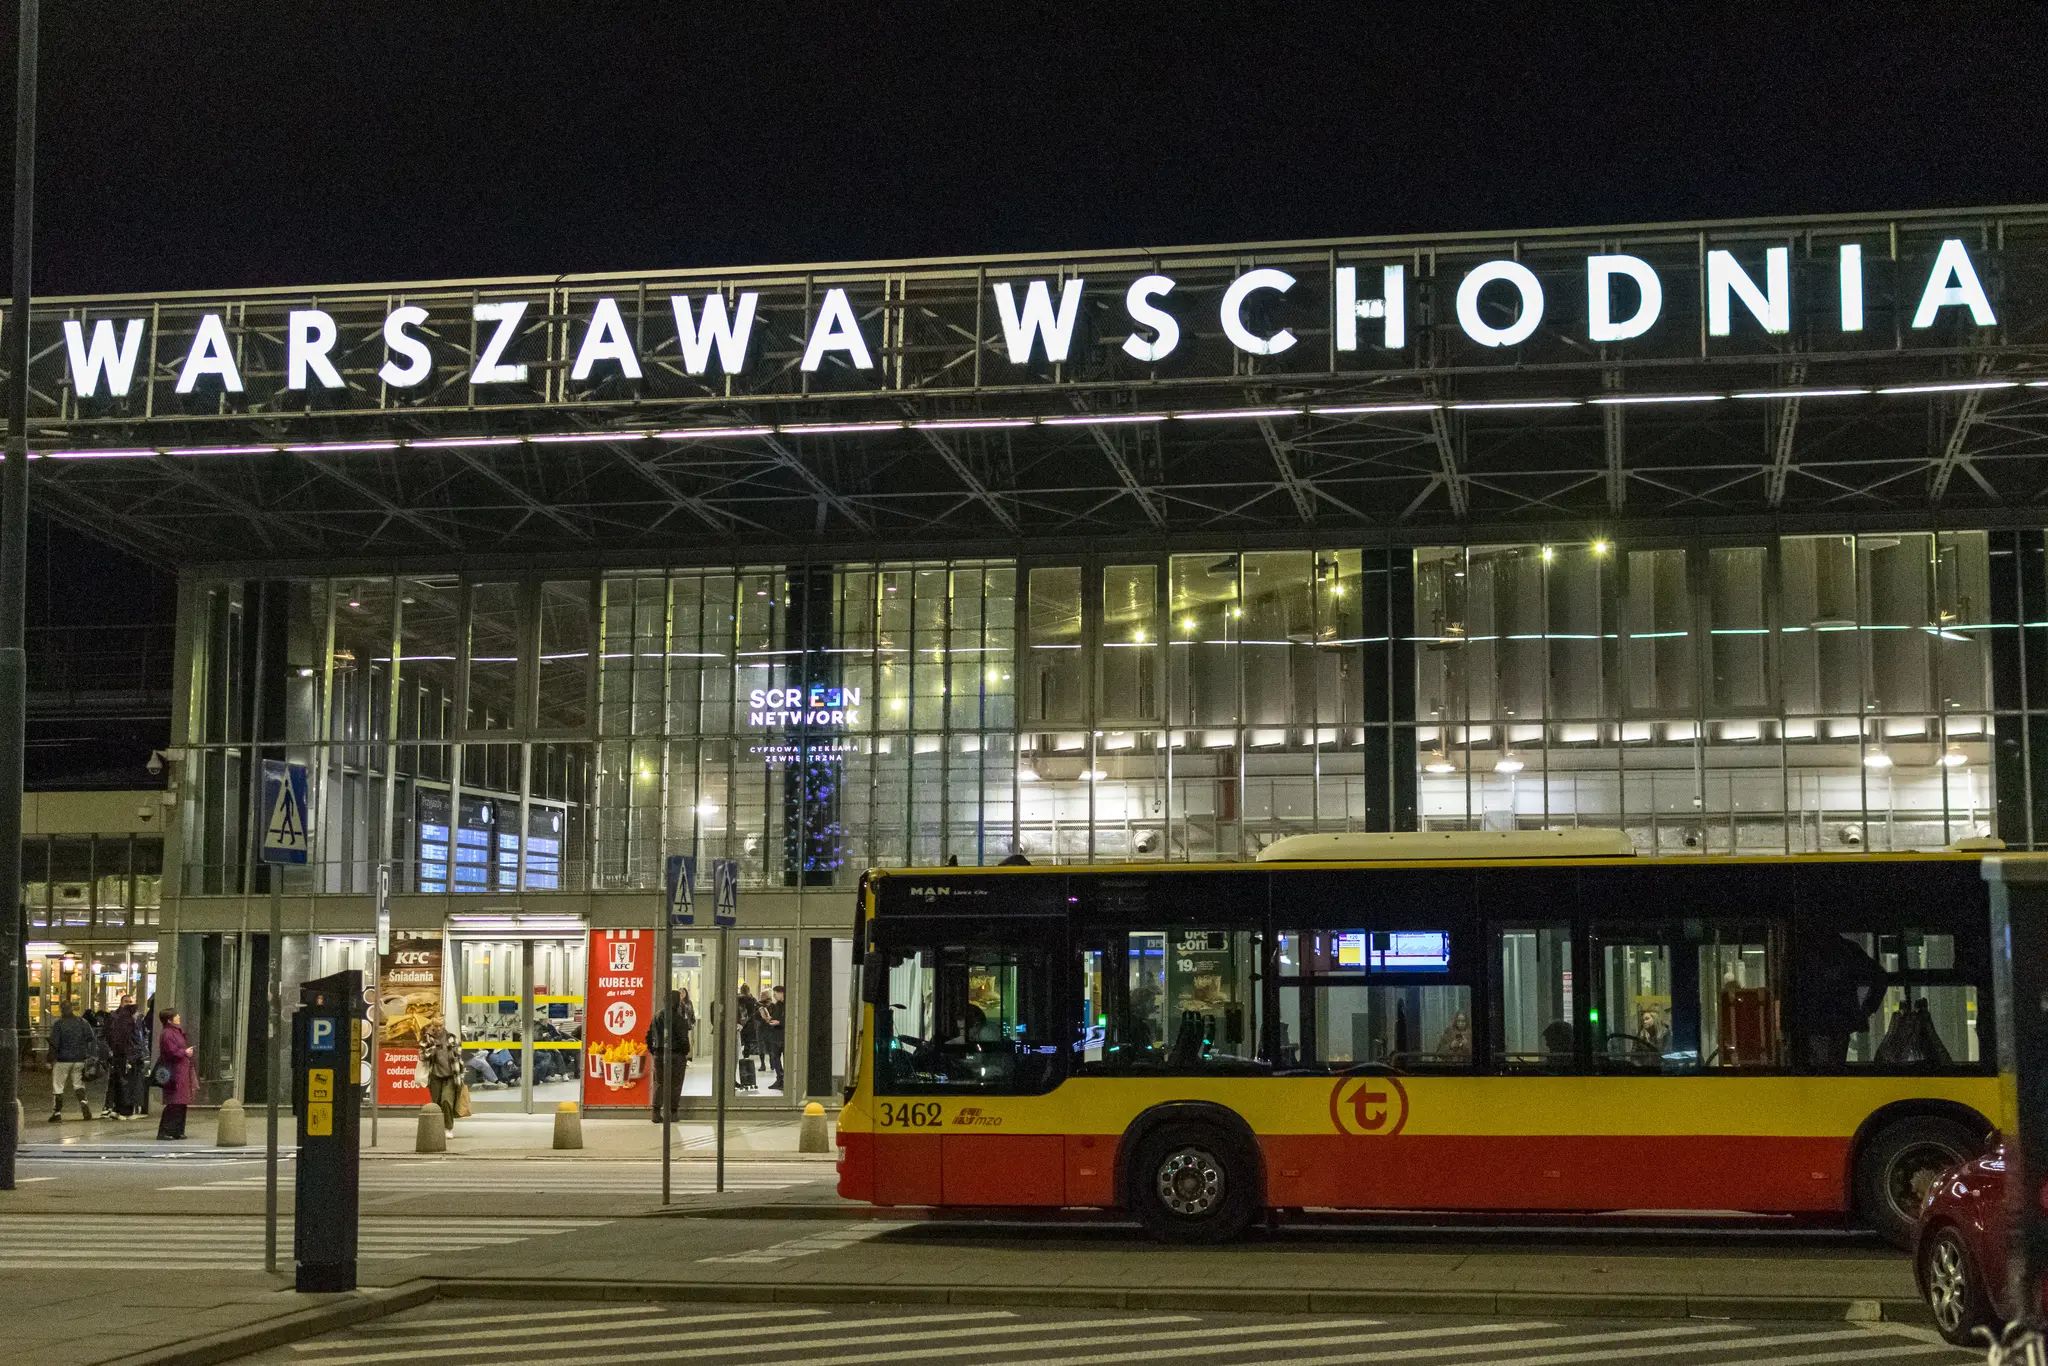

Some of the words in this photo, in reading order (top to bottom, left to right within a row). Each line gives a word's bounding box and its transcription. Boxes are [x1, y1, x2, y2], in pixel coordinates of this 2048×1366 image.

[63, 288, 875, 398] WARSZAWA
[992, 238, 1998, 365] WSCHODNIA
[749, 687, 861, 709] SCREEN
[750, 710, 860, 726] NETWORK
[749, 746, 799, 754] CYFROWA
[910, 887, 950, 895] MAN
[395, 952, 430, 965] KFC
[388, 969, 434, 982] Śniadania
[598, 977, 644, 988] KUBEŁEK
[608, 1010, 625, 1028] 14
[313, 1020, 333, 1045] P
[384, 1052, 419, 1063] Zaprasza
[392, 1080, 402, 1089] od
[879, 1102, 943, 1127] 3462
